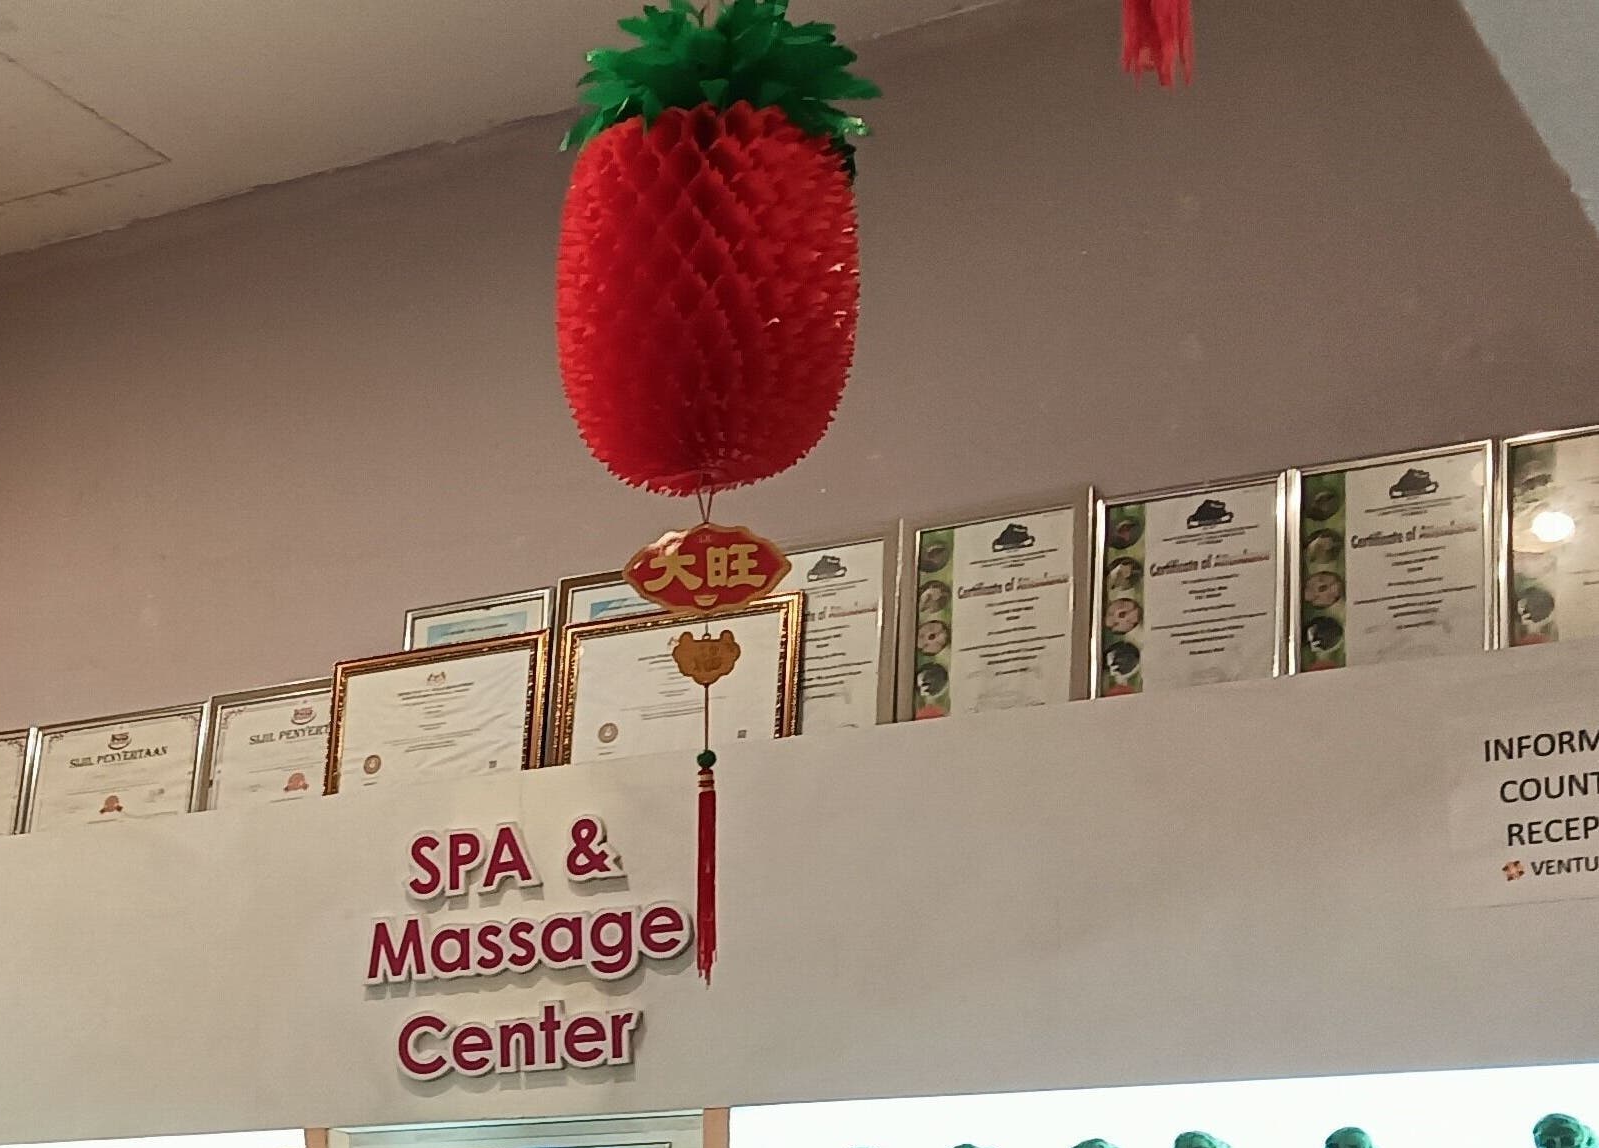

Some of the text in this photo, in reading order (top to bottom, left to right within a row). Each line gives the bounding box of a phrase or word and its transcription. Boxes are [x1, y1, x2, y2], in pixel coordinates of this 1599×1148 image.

[644, 544, 766, 592] 大旺
[1484, 729, 1599, 762] INFORM
[408, 817, 612, 895] SPA &
[1507, 815, 1599, 847] RECEP
[366, 906, 686, 975] Massage
[397, 1005, 635, 1076] Center
